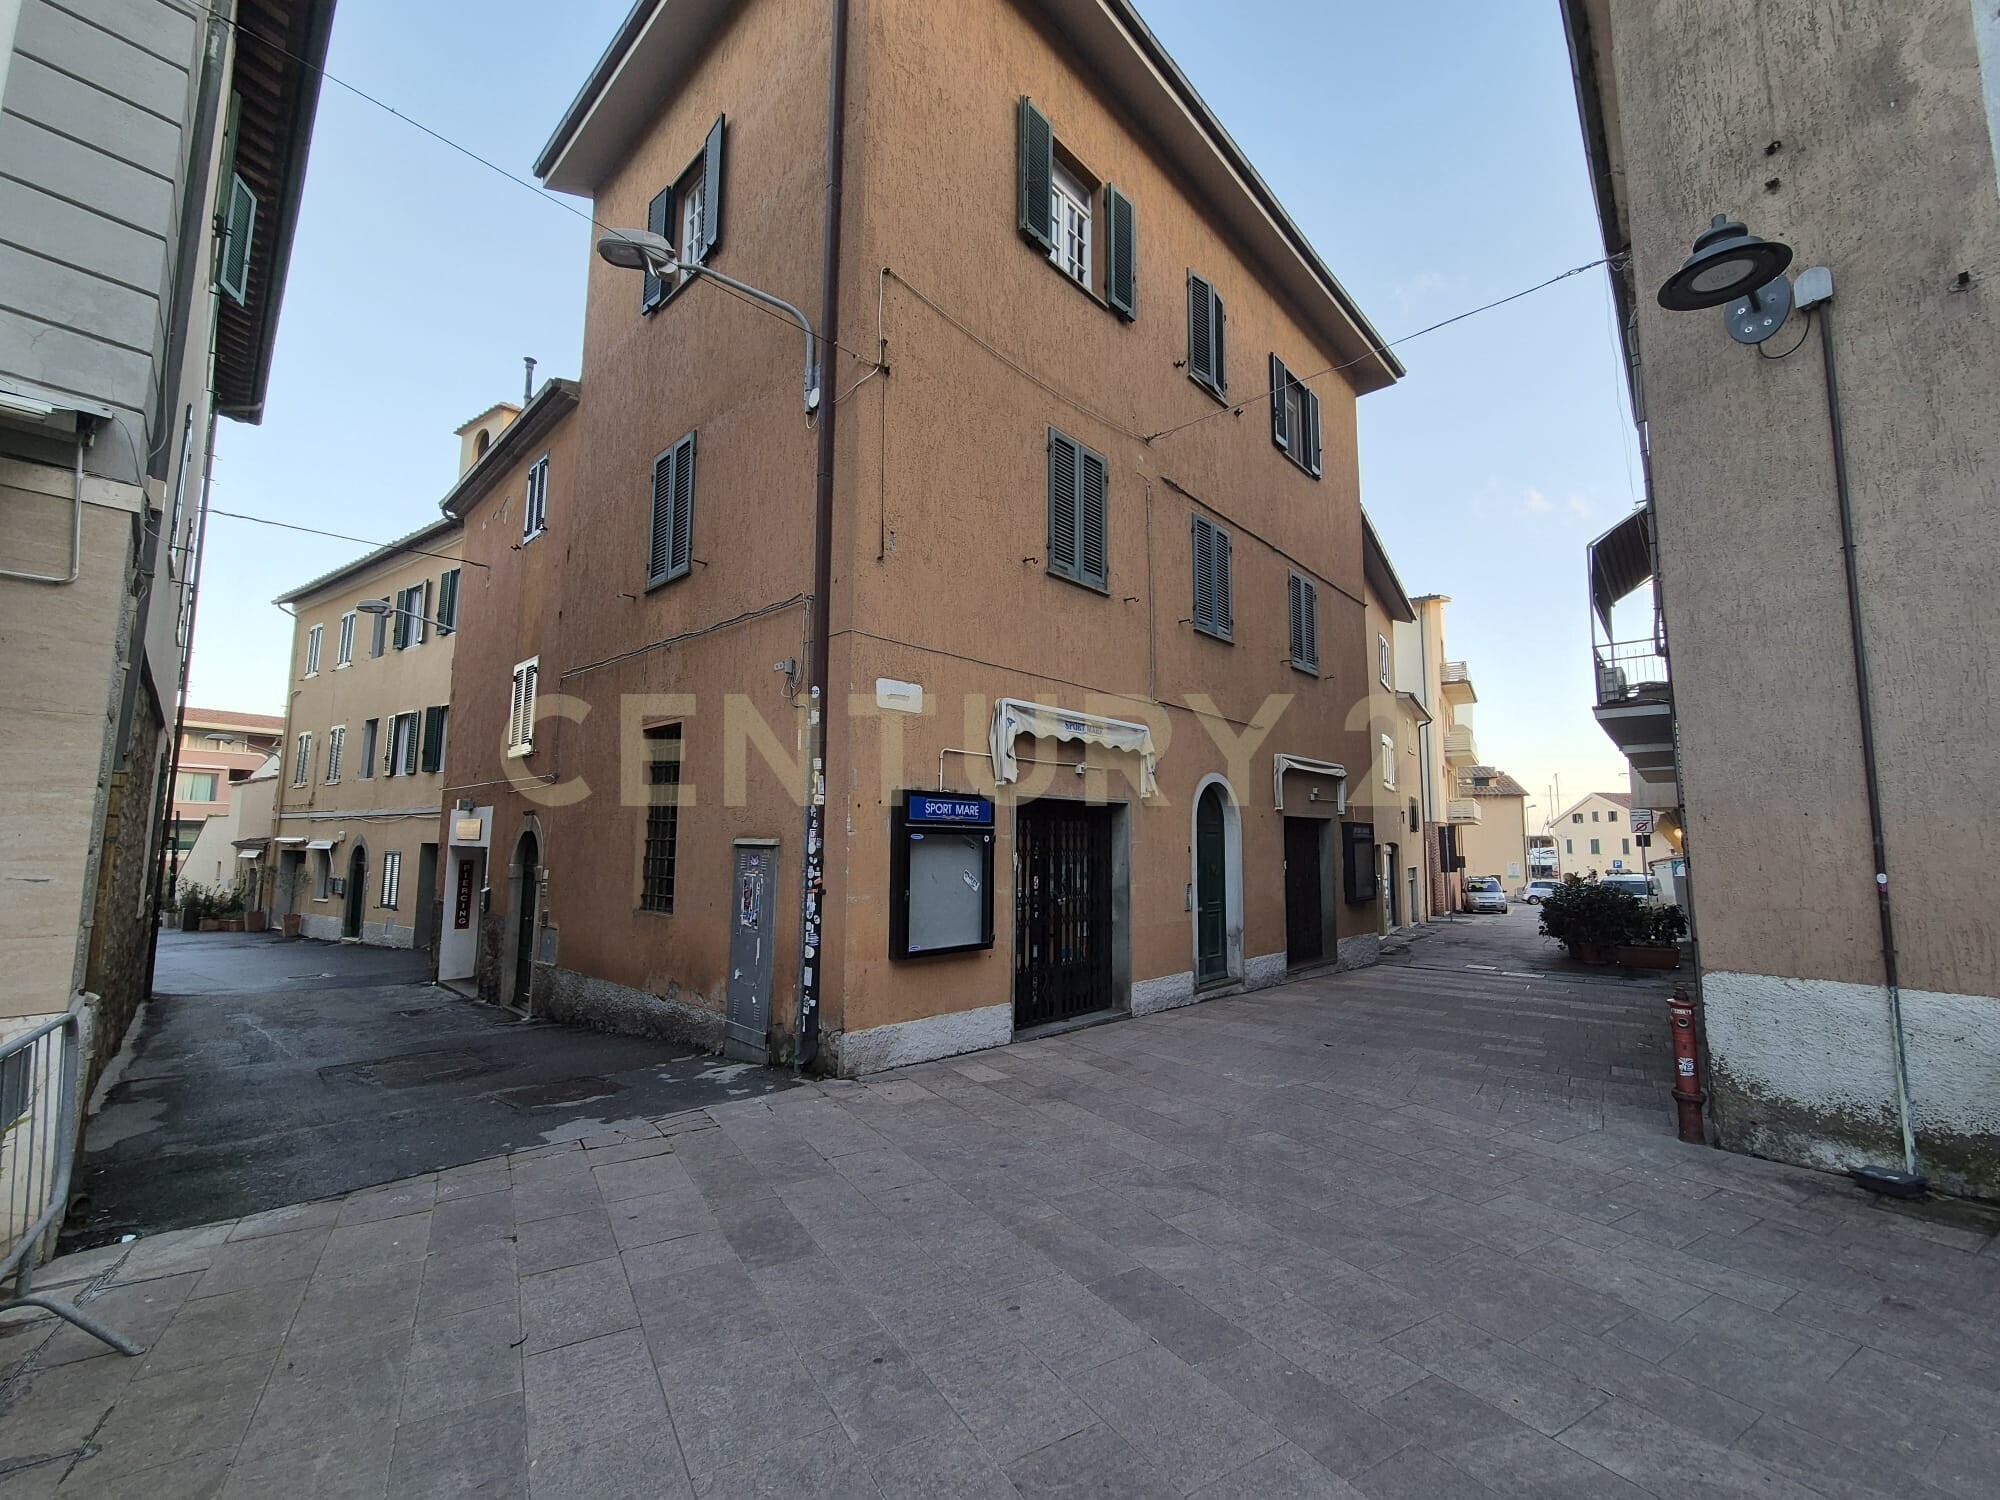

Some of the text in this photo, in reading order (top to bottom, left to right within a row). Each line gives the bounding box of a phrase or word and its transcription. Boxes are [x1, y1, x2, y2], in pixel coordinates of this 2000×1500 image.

[1064, 720, 1086, 732] SPORT
[925, 802, 980, 816] SPORT MARE
[458, 864, 470, 925] PIERCING
